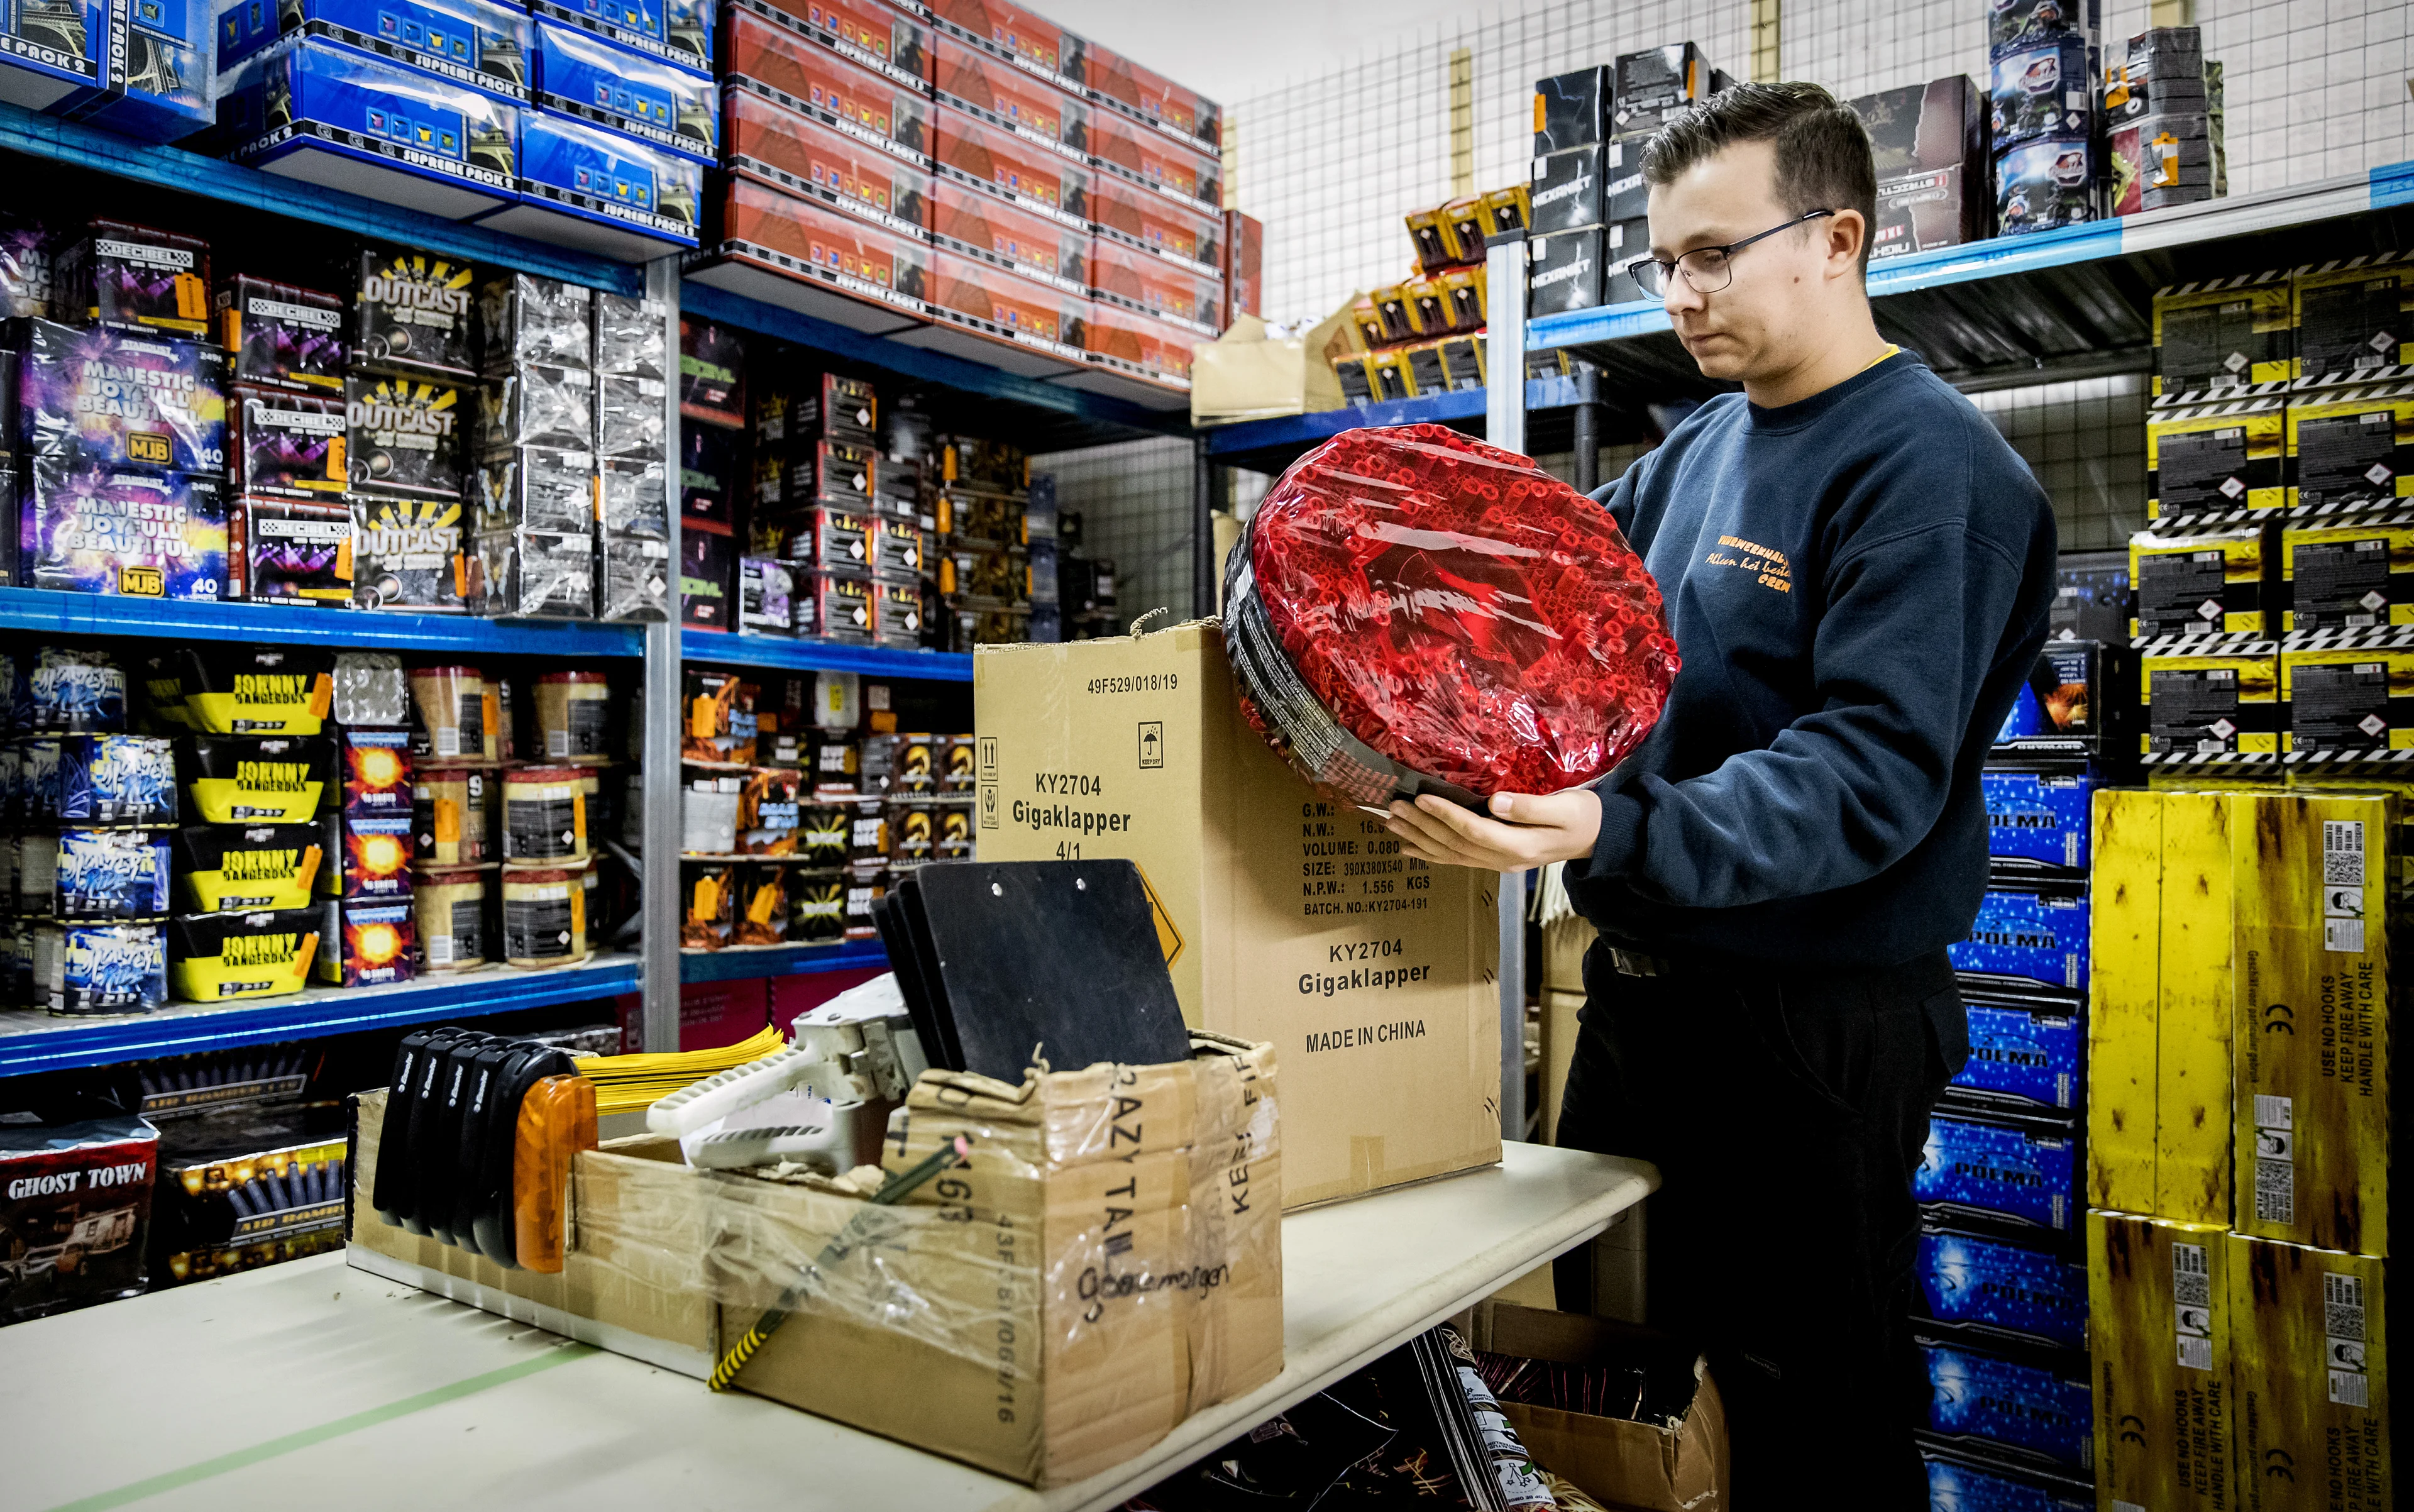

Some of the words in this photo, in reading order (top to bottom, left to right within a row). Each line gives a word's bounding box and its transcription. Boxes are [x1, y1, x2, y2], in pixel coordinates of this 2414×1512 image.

[14, 41, 70, 69] PACK
[74, 60, 86, 74] 2
[111, 26, 125, 70] PACK
[615, 29, 666, 54] SUPREME
[666, 45, 697, 67] PACK
[111, 71, 124, 85] 2
[415, 53, 475, 87] SUPREME
[476, 74, 515, 97] PACK
[517, 87, 526, 100] 2
[624, 119, 673, 146] SUPREME
[674, 136, 704, 155] PACK
[404, 151, 464, 180] SUPREME
[465, 165, 504, 185] PACK
[505, 175, 514, 190] 2
[1607, 173, 1642, 197] HEXA
[604, 202, 653, 226] SUPREME
[654, 216, 685, 236] PACK
[113, 243, 177, 262] DECIBEL
[364, 275, 471, 315] OUTCAST
[83, 360, 196, 392] MAJESTIC
[87, 379, 190, 409] JOYFULL
[77, 394, 205, 429] BEAUTIL
[346, 401, 455, 436] OUTCAST
[130, 439, 169, 461] MJB
[76, 497, 188, 524] MAJESTIC
[81, 516, 182, 541] JOYFULL
[356, 527, 463, 557] OUTCAST
[68, 532, 196, 560] BEAUTIFUL
[1740, 557, 1760, 571] het
[122, 574, 162, 593] MJB
[190, 578, 218, 595] 40
[1758, 573, 1791, 593] CREW
[233, 673, 308, 694] JOHNNY
[1087, 673, 1178, 694] 49F529/018/19
[236, 760, 311, 781] JOHNNY
[1035, 772, 1101, 797] KY2704
[1012, 800, 1131, 837] Gigaklapper
[1302, 802, 1335, 818] G.W.:
[1302, 822, 1335, 837] N.W.:
[221, 849, 299, 872] JOHNNY
[1055, 841, 1081, 861] 4/1
[1303, 841, 1359, 857] VOLUME:
[1367, 840, 1400, 855] 0.080
[223, 869, 296, 881] DANGEROUS
[1303, 861, 1336, 876] SIZE:
[1343, 859, 1403, 876] 390X380X540
[1303, 881, 1345, 897] N.P.W.:
[1362, 880, 1394, 894] 1.556
[1406, 876, 1431, 890] KGS
[1304, 901, 1344, 916] BATCH.
[221, 933, 298, 957] JOHNNY
[223, 952, 295, 967] DANGEROUS
[1329, 938, 1403, 963] KY2704
[1298, 963, 1431, 998] Gigaklapper
[2339, 972, 2354, 1011] AWAY
[2357, 962, 2373, 1000] CARE
[2321, 975, 2335, 1024] HOOKS
[2340, 1013, 2354, 1044] FIRE
[2358, 1002, 2373, 1037] WITH
[1306, 1028, 1353, 1053] MADE
[1357, 1025, 1374, 1046] IN
[1377, 1019, 1426, 1044] CHINA
[2322, 1027, 2335, 1047] NO
[2322, 1050, 2335, 1077] USE
[2340, 1047, 2354, 1083] KEEP
[2358, 1041, 2373, 1096] HANDLE
[8, 1171, 82, 1201] GHOST
[87, 1161, 148, 1190] TOWN
[2174, 1389, 2188, 1437] HOOKS
[2191, 1386, 2205, 1426] AWAY
[2207, 1380, 2221, 1416] CARE
[2176, 1439, 2189, 1459] NO
[2193, 1427, 2207, 1458] FIRE
[2208, 1420, 2223, 1453] WITH
[2344, 1426, 2360, 1465] AWAY
[2363, 1417, 2378, 1456] CARE
[2327, 1427, 2342, 1477] HOOKS
[2178, 1460, 2191, 1487] USE
[2195, 1459, 2208, 1496] KEEP
[2210, 1456, 2225, 1511] HANDLE
[2347, 1467, 2362, 1499] FIRE
[2365, 1459, 2380, 1494] WITH
[2329, 1479, 2343, 1500] NO
